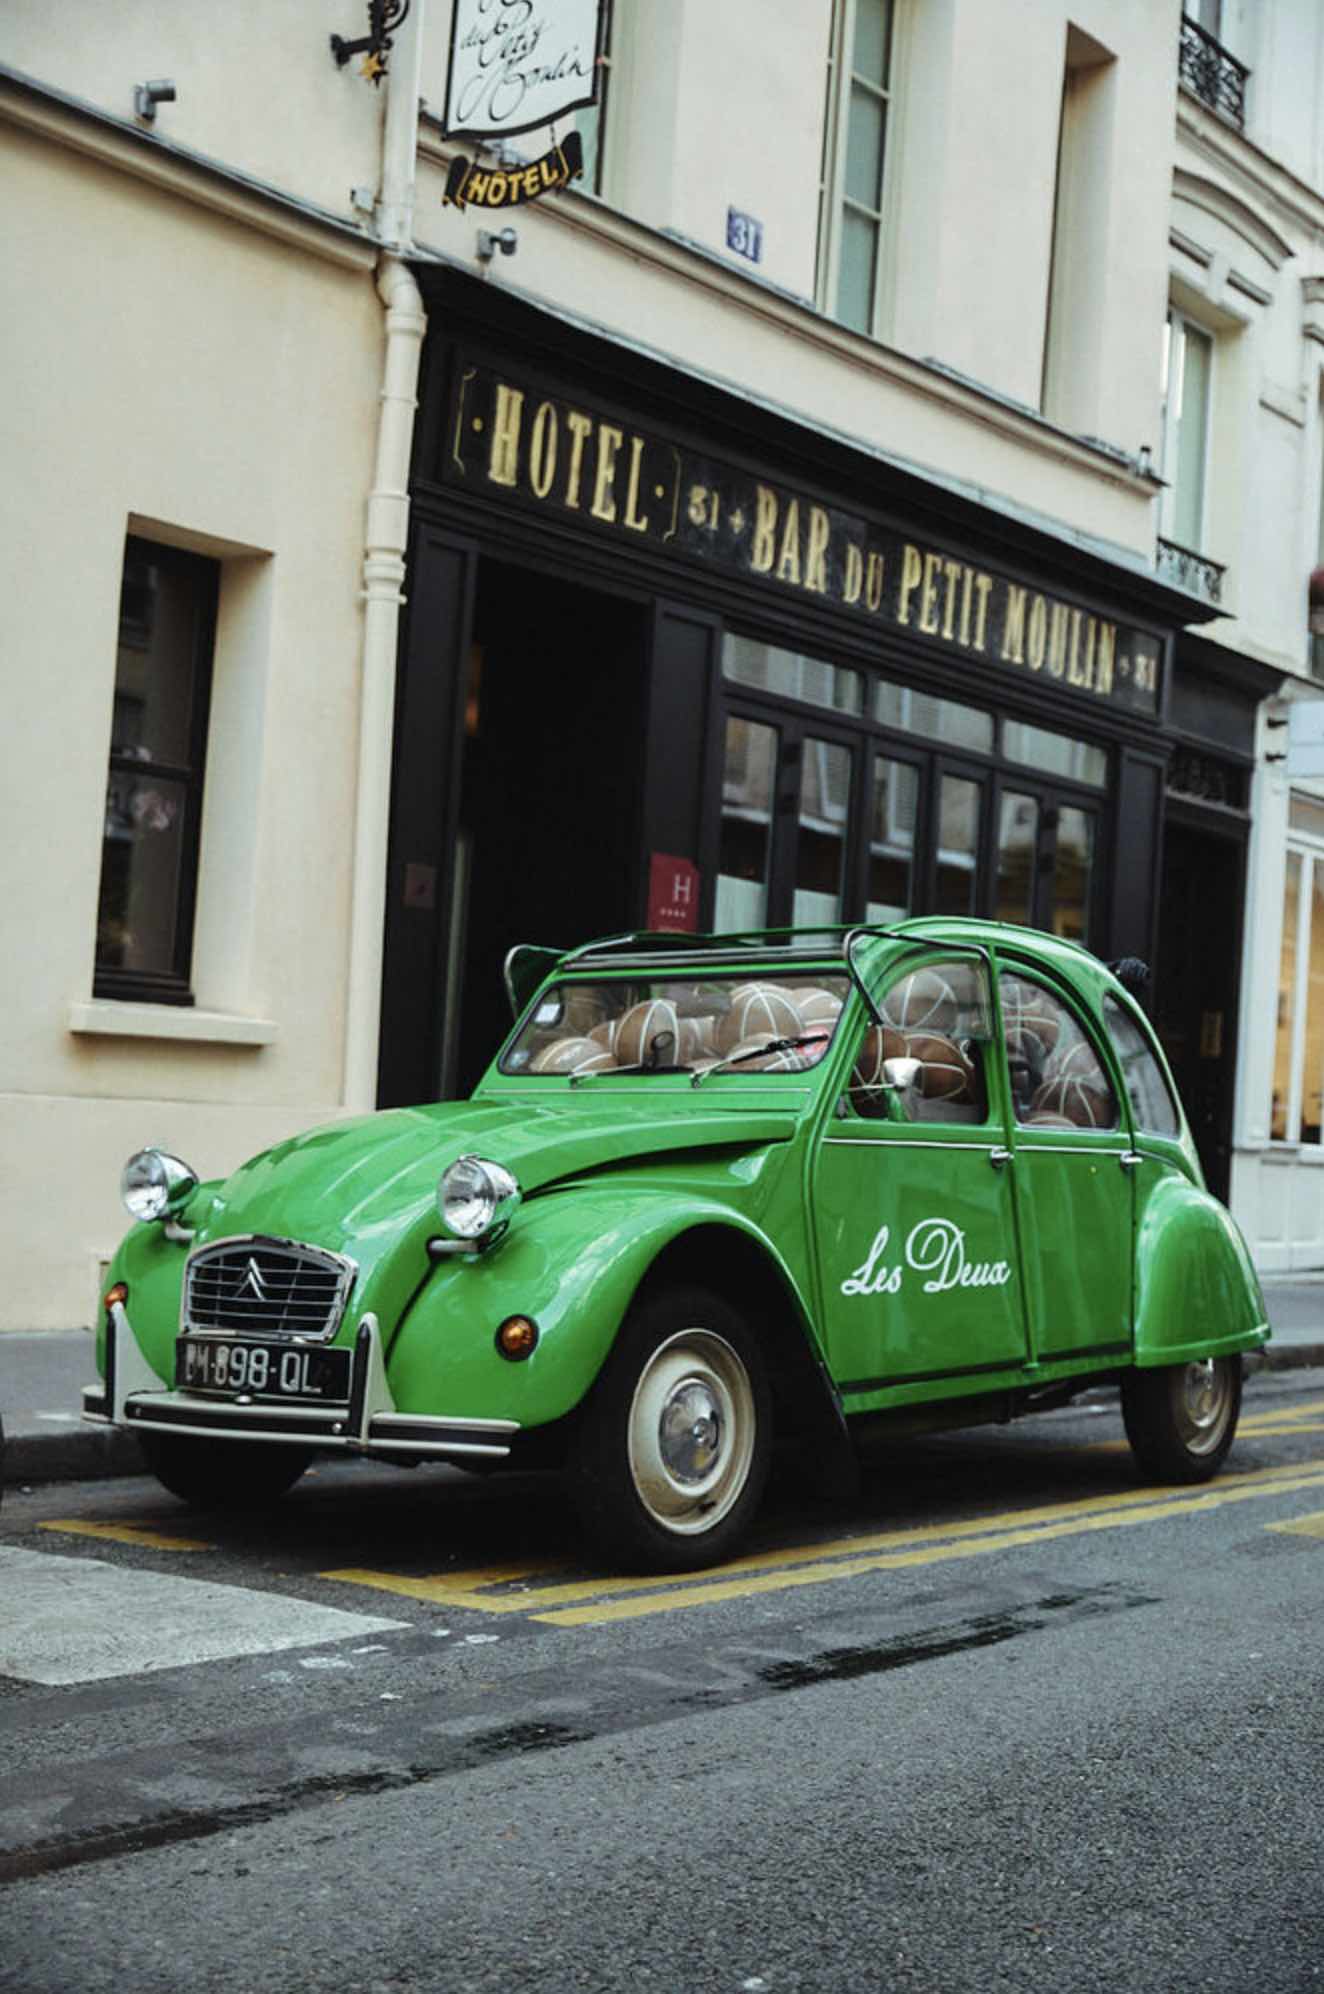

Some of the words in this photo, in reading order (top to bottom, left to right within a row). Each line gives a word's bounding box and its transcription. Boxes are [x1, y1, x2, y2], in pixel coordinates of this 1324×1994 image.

[733, 216, 756, 256] 31
[488, 383, 649, 532] HOTEL
[750, 484, 830, 594] BAR
[843, 542, 885, 613] DU
[897, 544, 993, 652] PETIT
[1001, 582, 1117, 695] MOULIN
[673, 873, 691, 902] H
[840, 1223, 903, 1295] Les
[905, 1216, 1012, 1293] Deux
